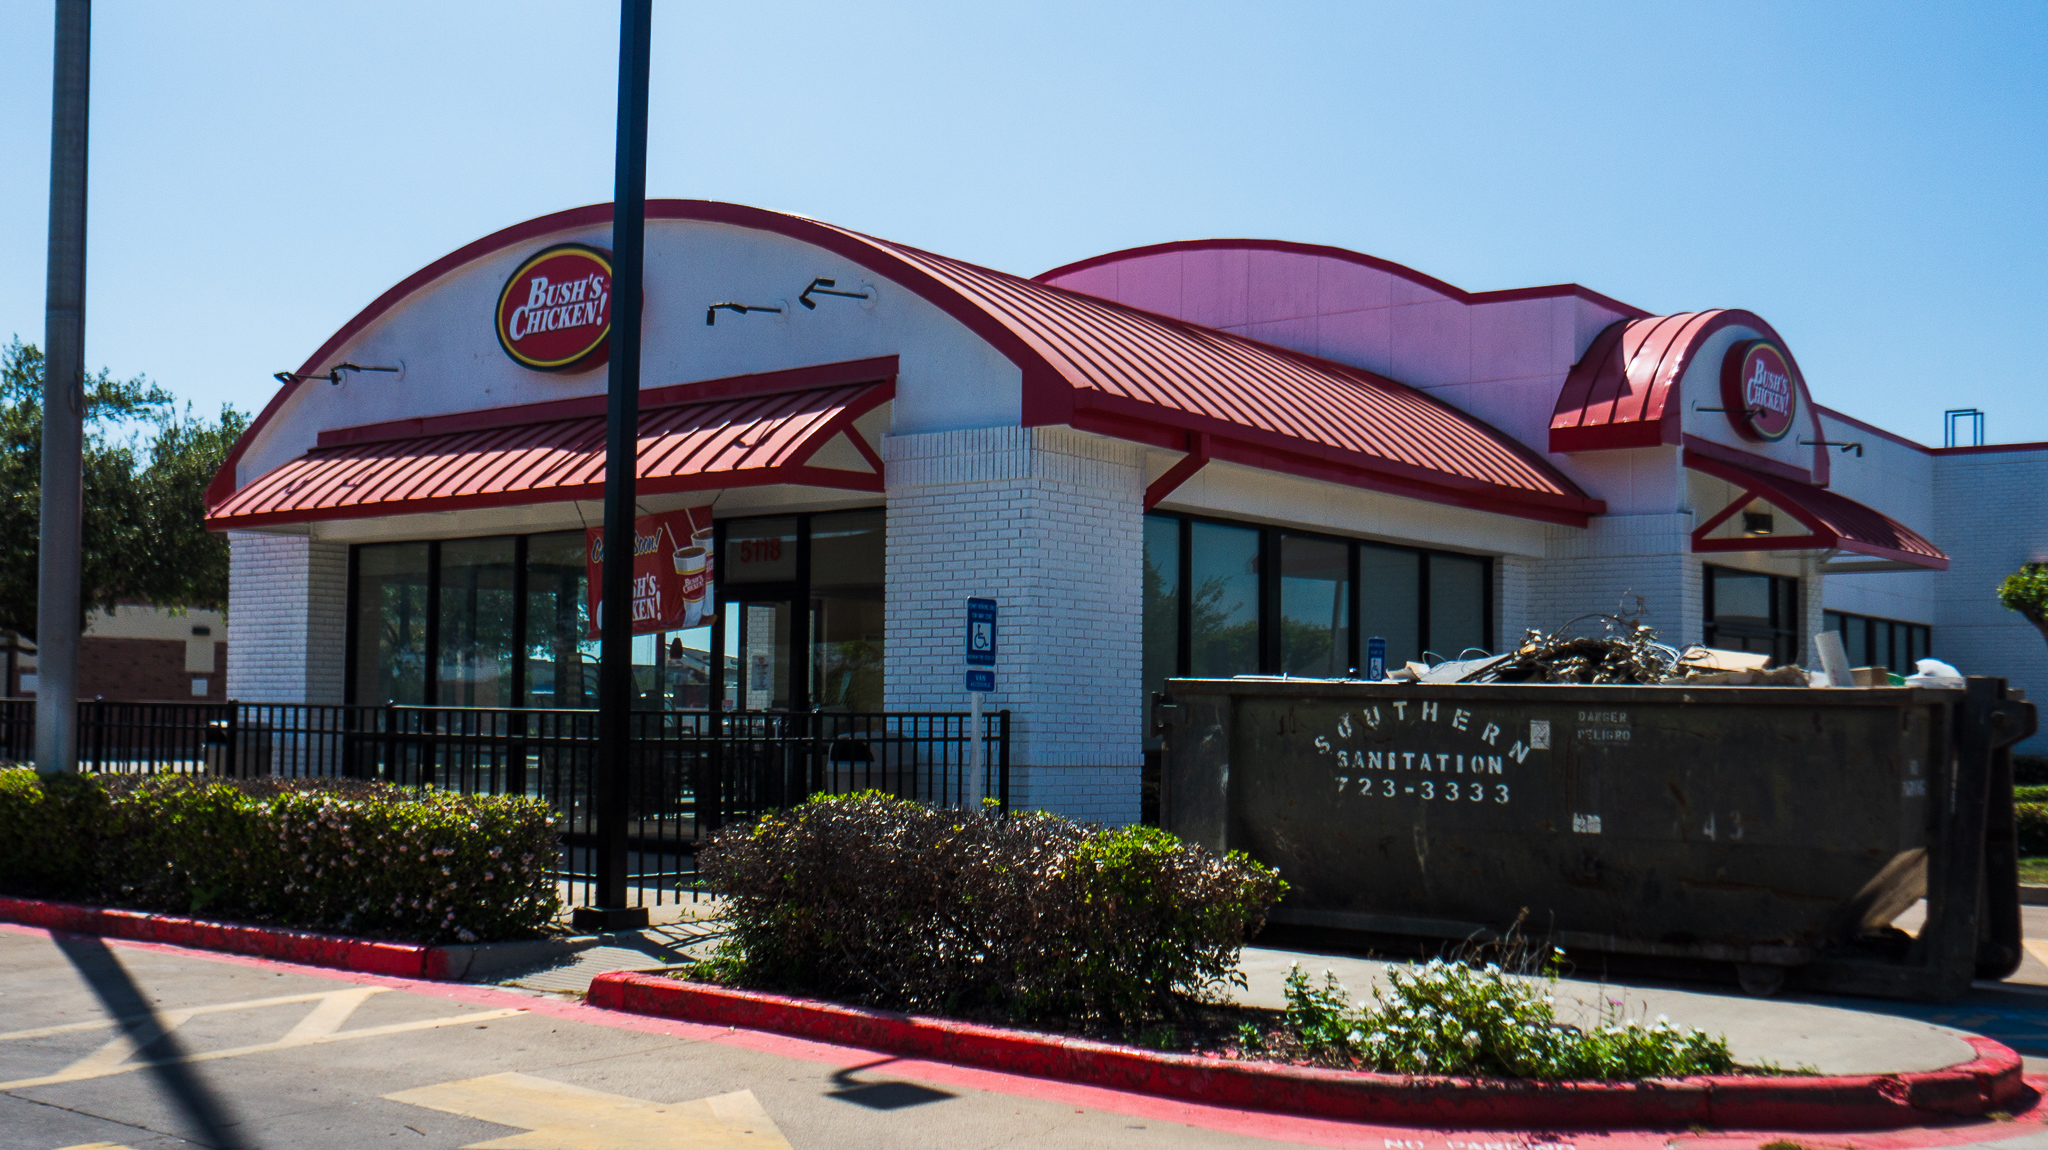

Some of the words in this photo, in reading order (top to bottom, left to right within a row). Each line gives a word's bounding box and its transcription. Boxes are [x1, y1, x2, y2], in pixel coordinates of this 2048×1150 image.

[526, 272, 604, 309] BUSH'S
[509, 292, 608, 341] CHICKEN!
[1754, 358, 1788, 396] BUSH'S
[1747, 377, 1790, 417] CHICKEN!
[739, 538, 782, 563] 5118
[1314, 701, 1530, 764] SOUTHERN
[1336, 750, 1503, 775] SANITATION
[1334, 776, 1510, 805] 723-3333
